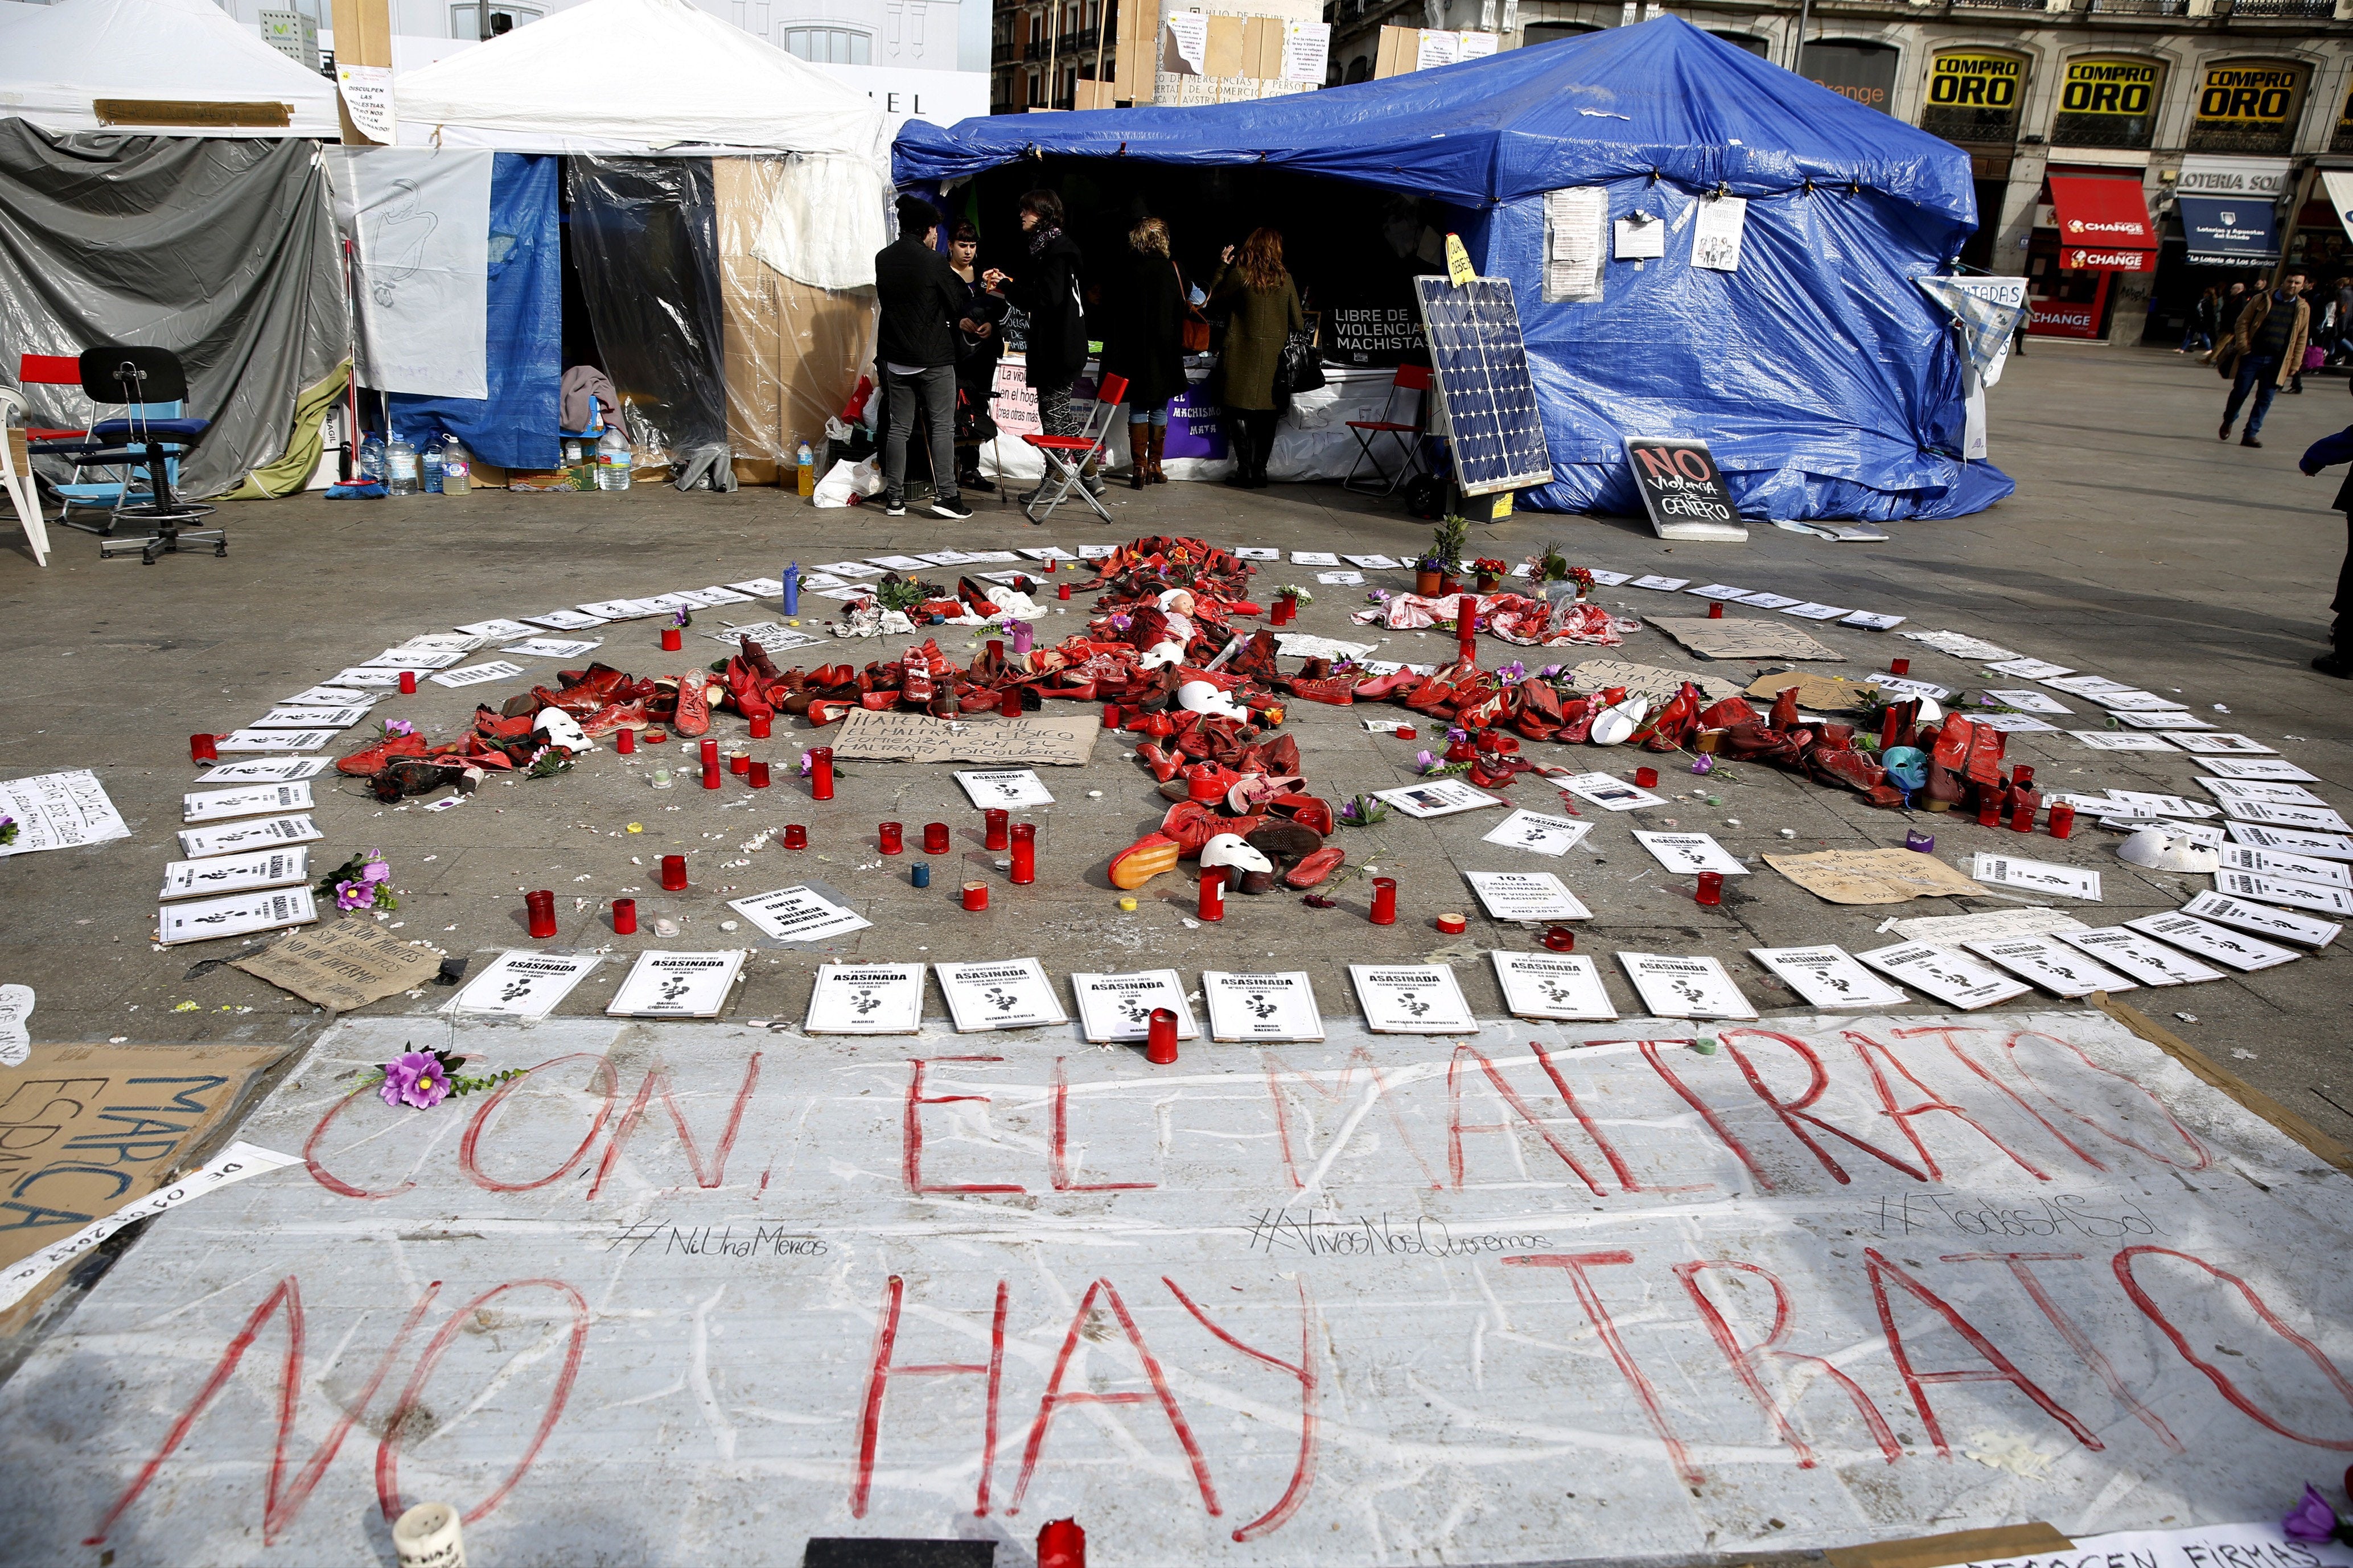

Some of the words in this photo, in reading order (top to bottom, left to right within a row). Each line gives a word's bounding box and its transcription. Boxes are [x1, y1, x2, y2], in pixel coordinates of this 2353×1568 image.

[1935, 58, 2020, 76] COMPRO
[2068, 65, 2155, 82] COMPRO
[2207, 71, 2296, 88] COMPRO
[1931, 75, 2016, 105] ORO
[2063, 81, 2151, 113] ORO
[350, 99, 385, 109] MOLESTIAS,
[2199, 88, 2292, 118] ORO
[2178, 172, 2244, 190] LOTERIA
[2248, 175, 2281, 192] SOL
[1721, 198, 1739, 207] SOMOS
[2084, 223, 2144, 233] CHANGE
[2087, 254, 2143, 266] CHANGE
[1335, 308, 1381, 322] LIBRE
[1388, 308, 1408, 321] DE
[2030, 312, 2091, 326] CHANGE
[1009, 330, 1023, 340] DE
[1002, 367, 1011, 380] La
[1000, 389, 1009, 399] en
[1011, 388, 1018, 401] el
[1021, 388, 1039, 406] hoga
[998, 408, 1010, 419] crea
[1010, 409, 1025, 421] otras
[1026, 409, 1040, 423] más.
[1173, 406, 1221, 418] MACHISMO
[1189, 424, 1217, 435] MATA
[1634, 447, 1711, 481] NO
[1679, 492, 1701, 500] DE
[1661, 497, 1730, 521] GÉNERO
[880, 727, 981, 738] MALTRATO
[996, 727, 1074, 741] FÍSICO
[837, 744, 937, 754] MALTRATO
[845, 737, 951, 746] COMIENZA
[969, 739, 1008, 748] CON
[278, 787, 292, 806] ASASINADA
[277, 820, 298, 838] ASASINADA
[1521, 816, 1577, 831] ASASINADA
[2240, 849, 2253, 869] ASASINADA
[269, 855, 283, 879] ASASINADA
[2238, 875, 2252, 894] ASASINADA
[741, 893, 775, 905] GABINETE
[784, 887, 807, 896] CRISIS
[273, 895, 289, 920] ASASINADA
[764, 898, 803, 910] CONTRA
[773, 906, 823, 921] VIOLENCIA
[780, 912, 830, 926] MACHISTA
[820, 918, 843, 927] ESTADO
[1923, 916, 1997, 931] QUIERES
[1981, 925, 2010, 934] DE
[2015, 921, 2043, 930] LAS
[2153, 919, 2199, 933] ASASINADA
[332, 921, 353, 931] NO
[348, 924, 381, 941] SON
[369, 939, 425, 963] MUERTES
[2078, 935, 2136, 945] ASASINADA
[310, 930, 337, 945] SON
[332, 941, 401, 973] ASESINATOS
[1883, 949, 1938, 966] ASASINADA
[1990, 944, 2048, 956] ASASINADA
[282, 939, 307, 952] NO
[320, 957, 382, 984] ENFERMOS
[506, 961, 577, 972] ASASINADA
[1511, 962, 1581, 972] ASASINADA
[1639, 962, 1708, 972] ASASINADA
[1775, 955, 1840, 964] ASASINADA
[956, 969, 1028, 980] ASASINADA
[1092, 981, 1165, 990] ASASINADA
[902, 1053, 1157, 1195] EL
[1263, 1027, 2214, 1197] MALTRATO
[0, 1073, 229, 1232] MARCA
[606, 1216, 829, 1257] #NiUnaMenos
[83, 1275, 590, 1547] NO
[853, 1271, 1318, 1544] HAY
[1501, 1244, 2353, 1485] TRATO
